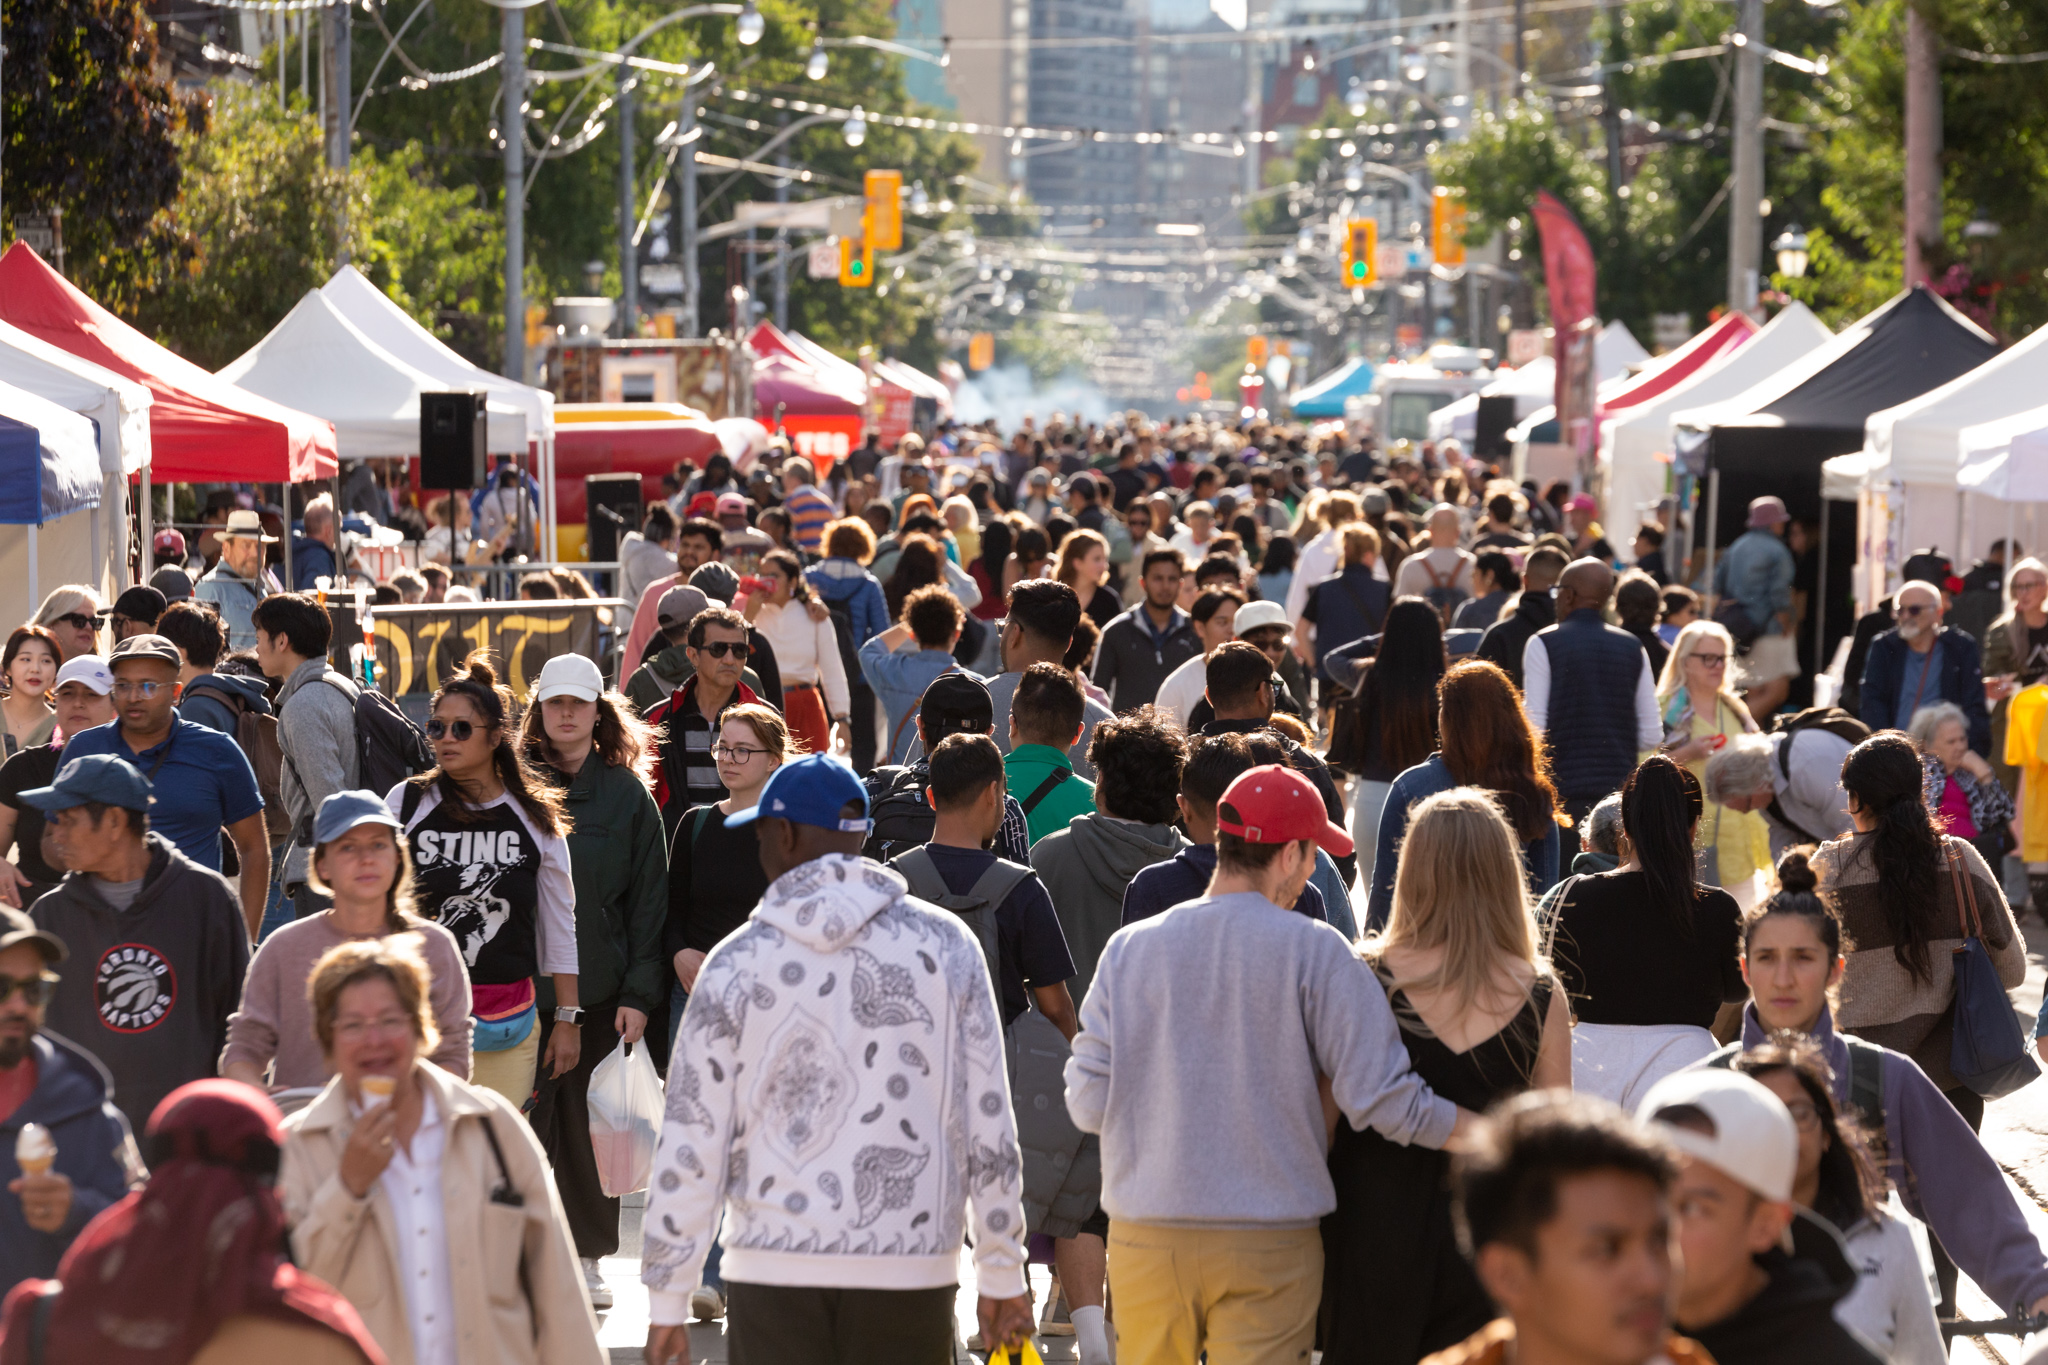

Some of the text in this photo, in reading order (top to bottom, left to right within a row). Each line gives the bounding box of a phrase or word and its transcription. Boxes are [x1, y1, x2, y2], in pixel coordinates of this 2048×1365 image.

[416, 830, 520, 865] STING
[97, 948, 168, 983] TORONTO
[100, 994, 171, 1028] RAPTORS
